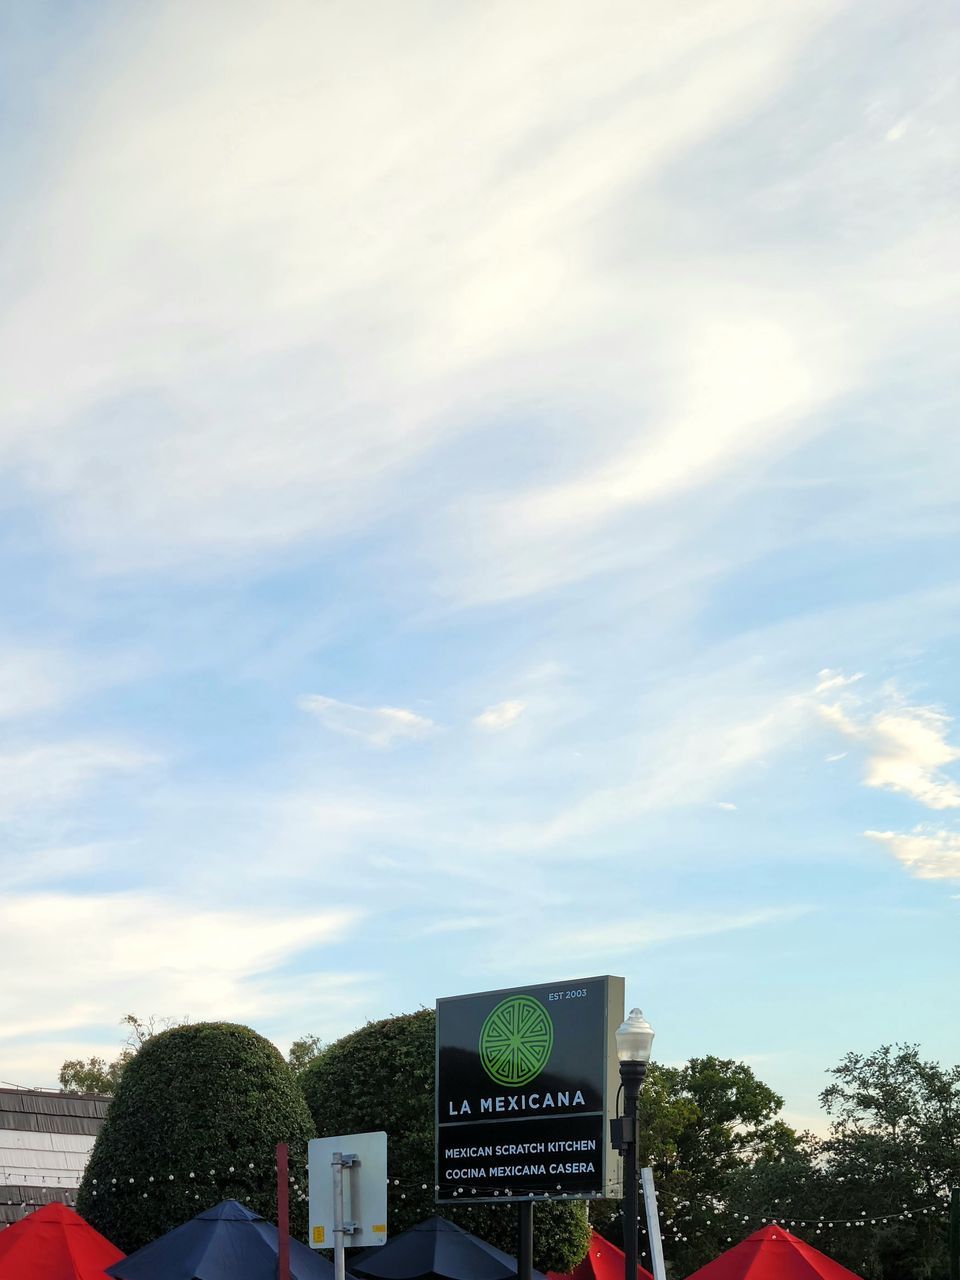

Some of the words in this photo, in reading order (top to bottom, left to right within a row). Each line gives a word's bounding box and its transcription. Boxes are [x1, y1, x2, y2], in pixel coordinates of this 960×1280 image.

[548, 992, 564, 1001] EST
[565, 988, 587, 1000] 2003
[449, 1099, 472, 1116] LA
[480, 1090, 586, 1113] MEXICANA
[445, 1146, 493, 1159] MEXICAN
[495, 1143, 545, 1156] SCRATCH
[548, 1140, 596, 1152] KITCHEN
[445, 1168, 486, 1179] COCINA
[489, 1165, 546, 1177] MEXICANA
[549, 1162, 595, 1174] CASERA
